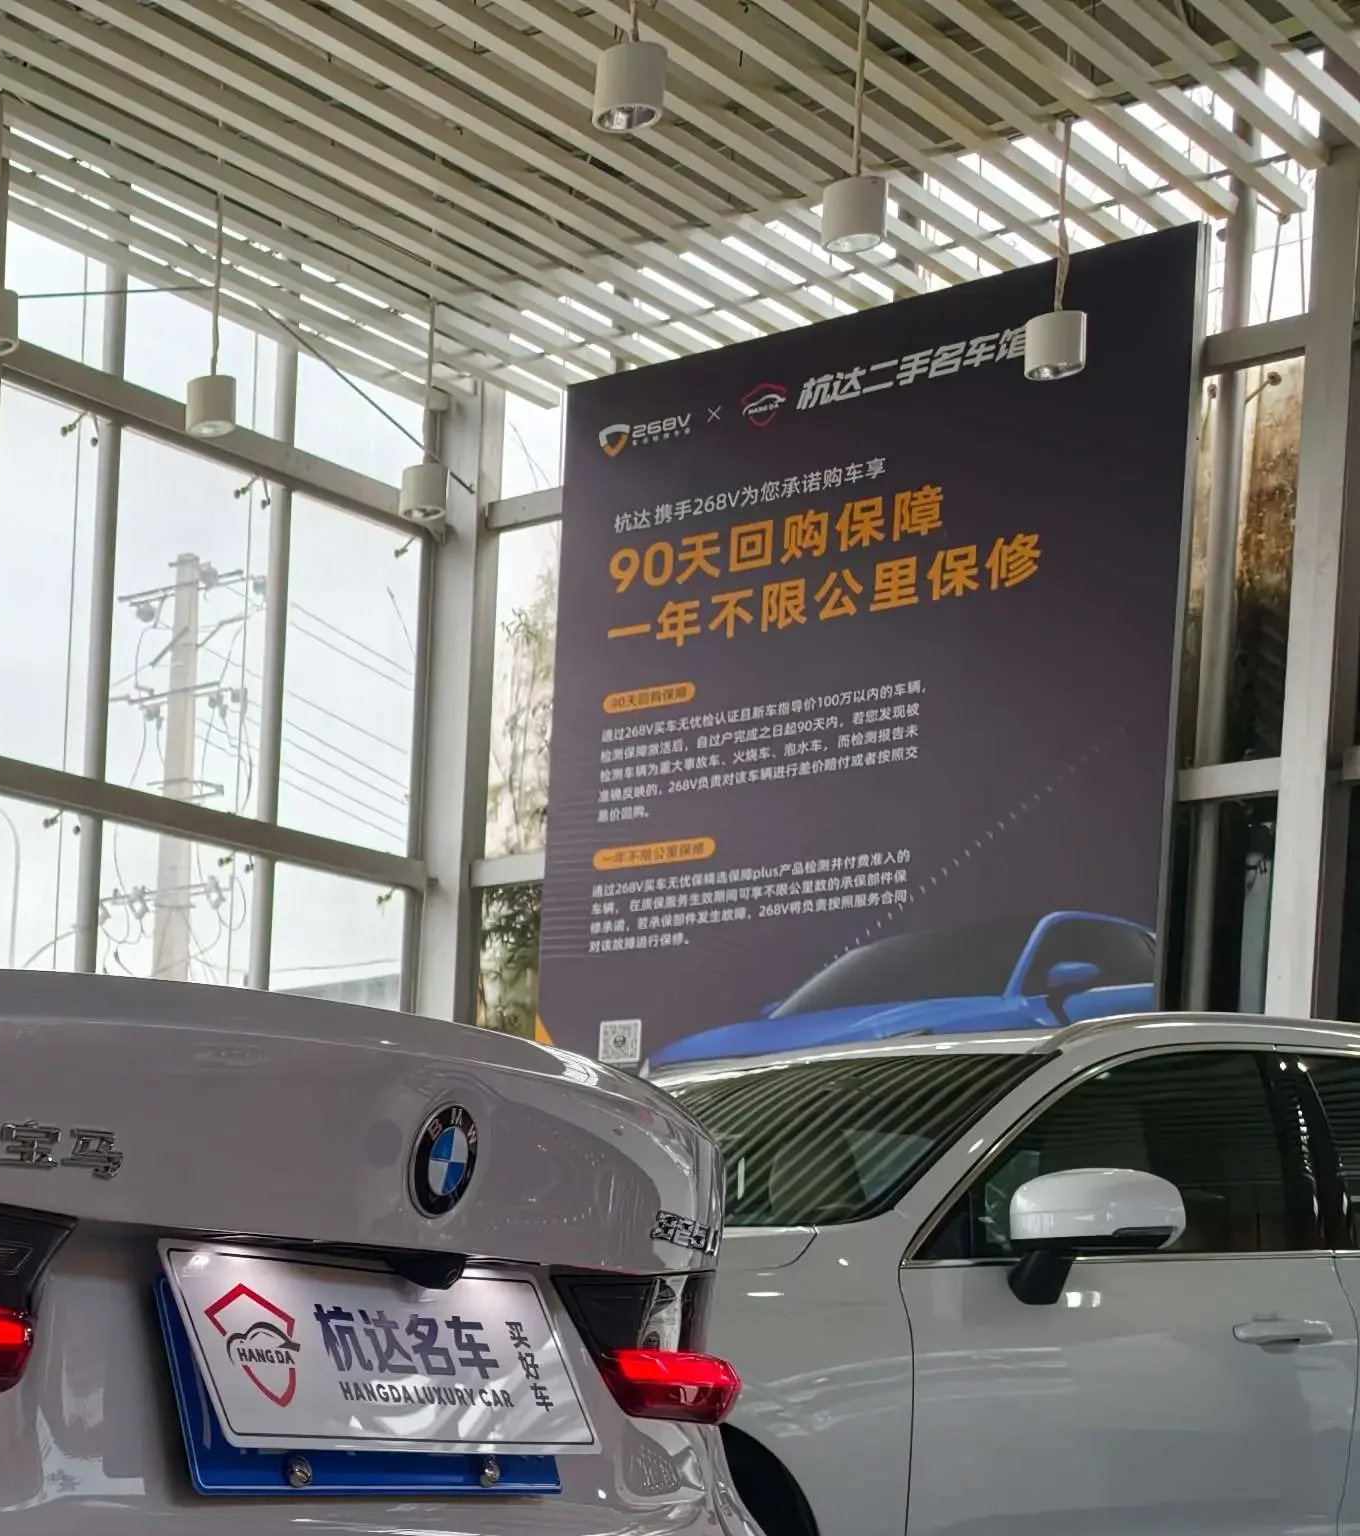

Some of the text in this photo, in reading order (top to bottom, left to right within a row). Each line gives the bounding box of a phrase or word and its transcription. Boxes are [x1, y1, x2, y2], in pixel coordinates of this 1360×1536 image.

[632, 413, 691, 438] 268V
[613, 456, 886, 534] 杭达 携手268V为您承诺购车享
[608, 484, 944, 596] 90天回购保障
[607, 532, 1042, 647] 一年不限公里保修
[237, 1347, 295, 1365] HANG DA
[314, 1303, 499, 1380] 杭达名车
[505, 1320, 554, 1412] 买好车
[482, 1390, 514, 1408] CAR
